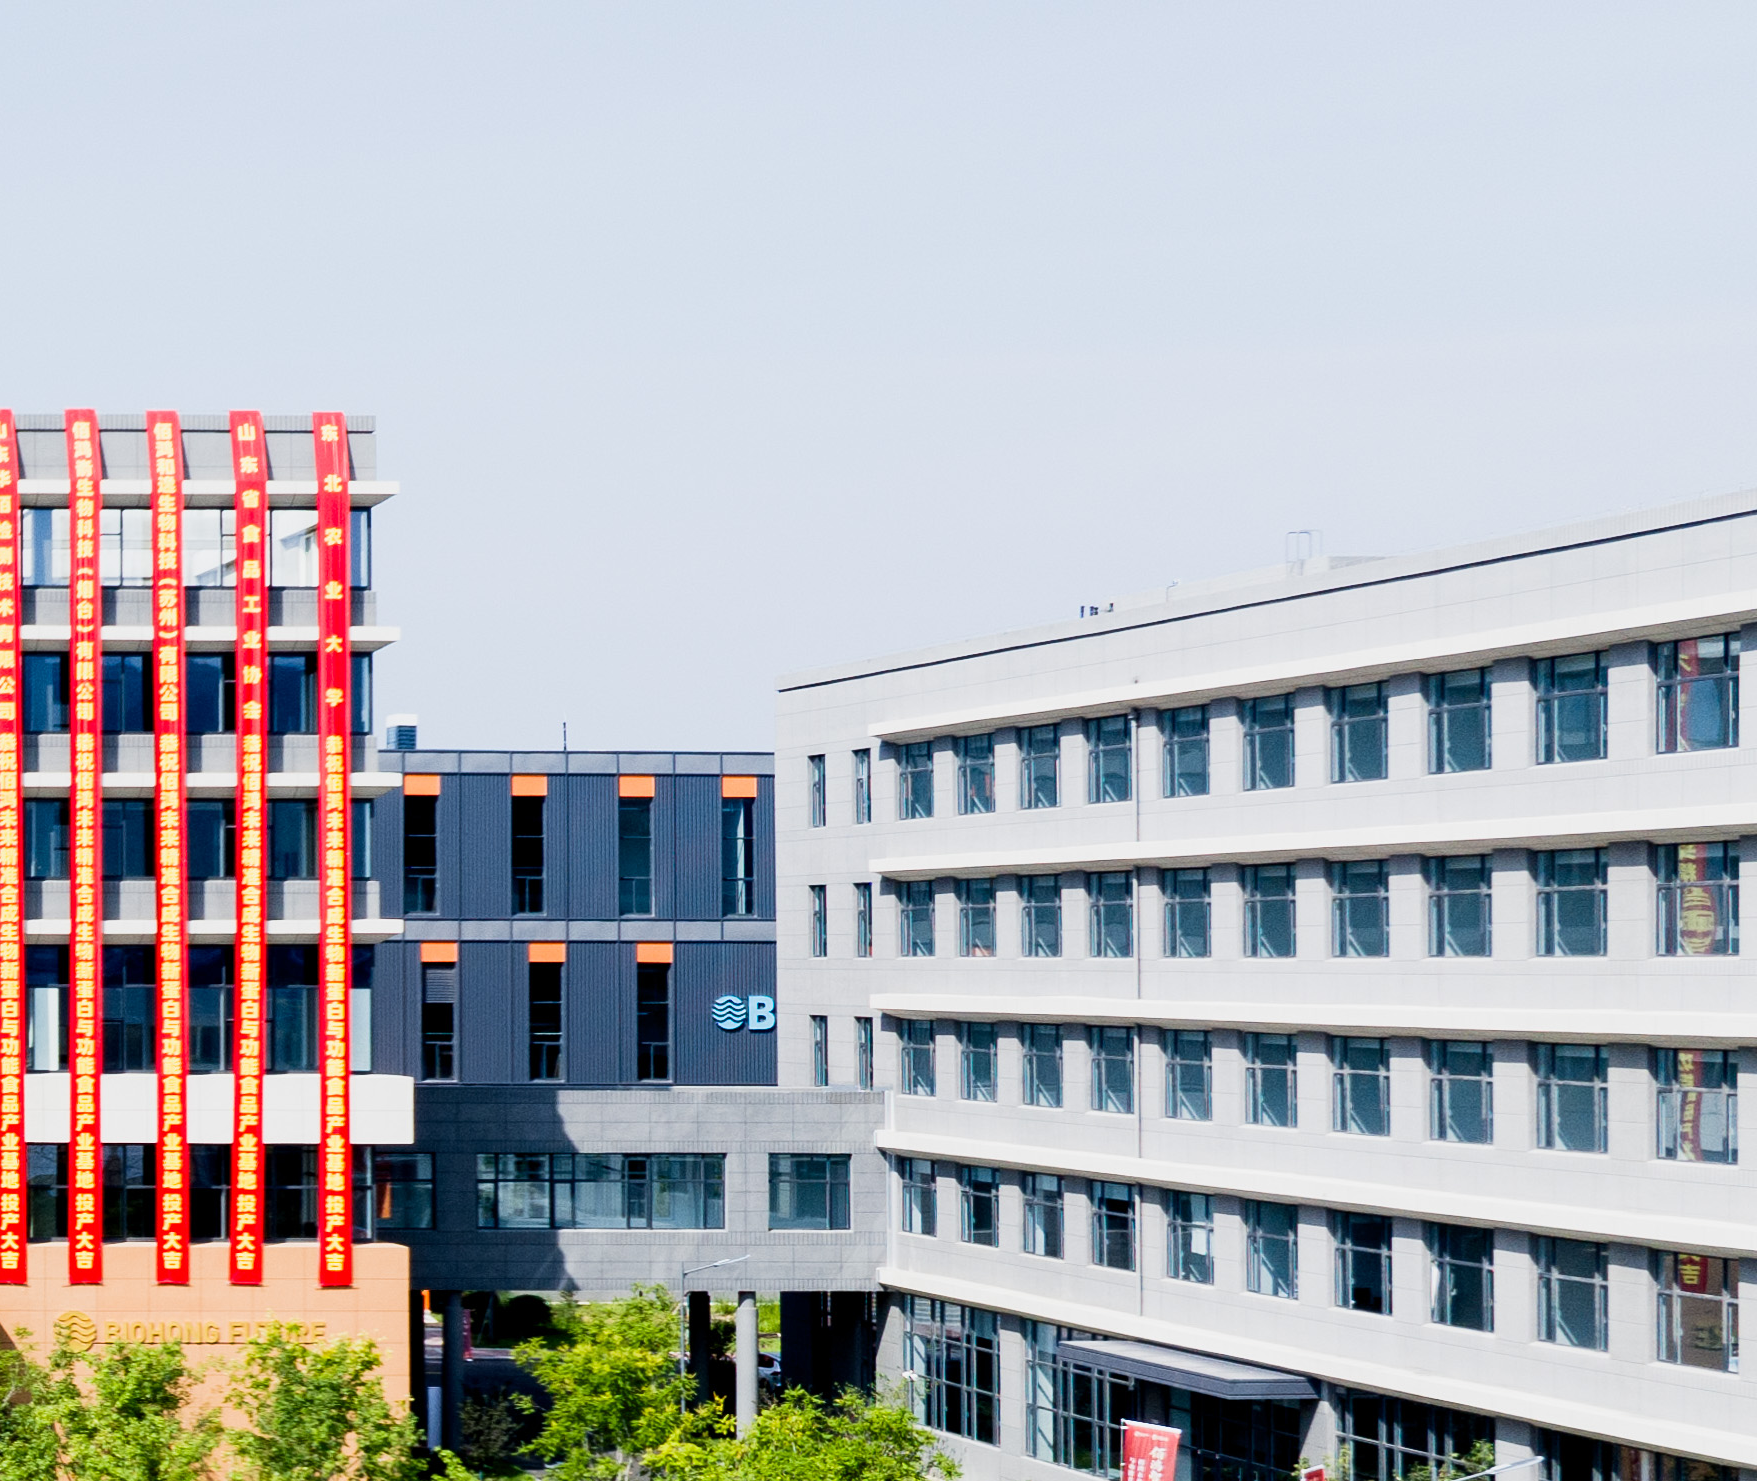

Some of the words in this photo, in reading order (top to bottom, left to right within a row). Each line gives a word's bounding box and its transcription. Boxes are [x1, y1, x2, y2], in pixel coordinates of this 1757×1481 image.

[237, 422, 262, 720] 山东省食品工业协会
[320, 423, 343, 707] 东北农业大学
[748, 995, 776, 1030] B
[0, 1193, 20, 1269] 投产大吉
[75, 1193, 94, 1269] 投产大吉
[162, 1193, 182, 1269] 投产大吉
[236, 1194, 256, 1270] 投产大吉
[325, 1195, 345, 1271] 投产大吉
[103, 1321, 220, 1344] BIOHONG
